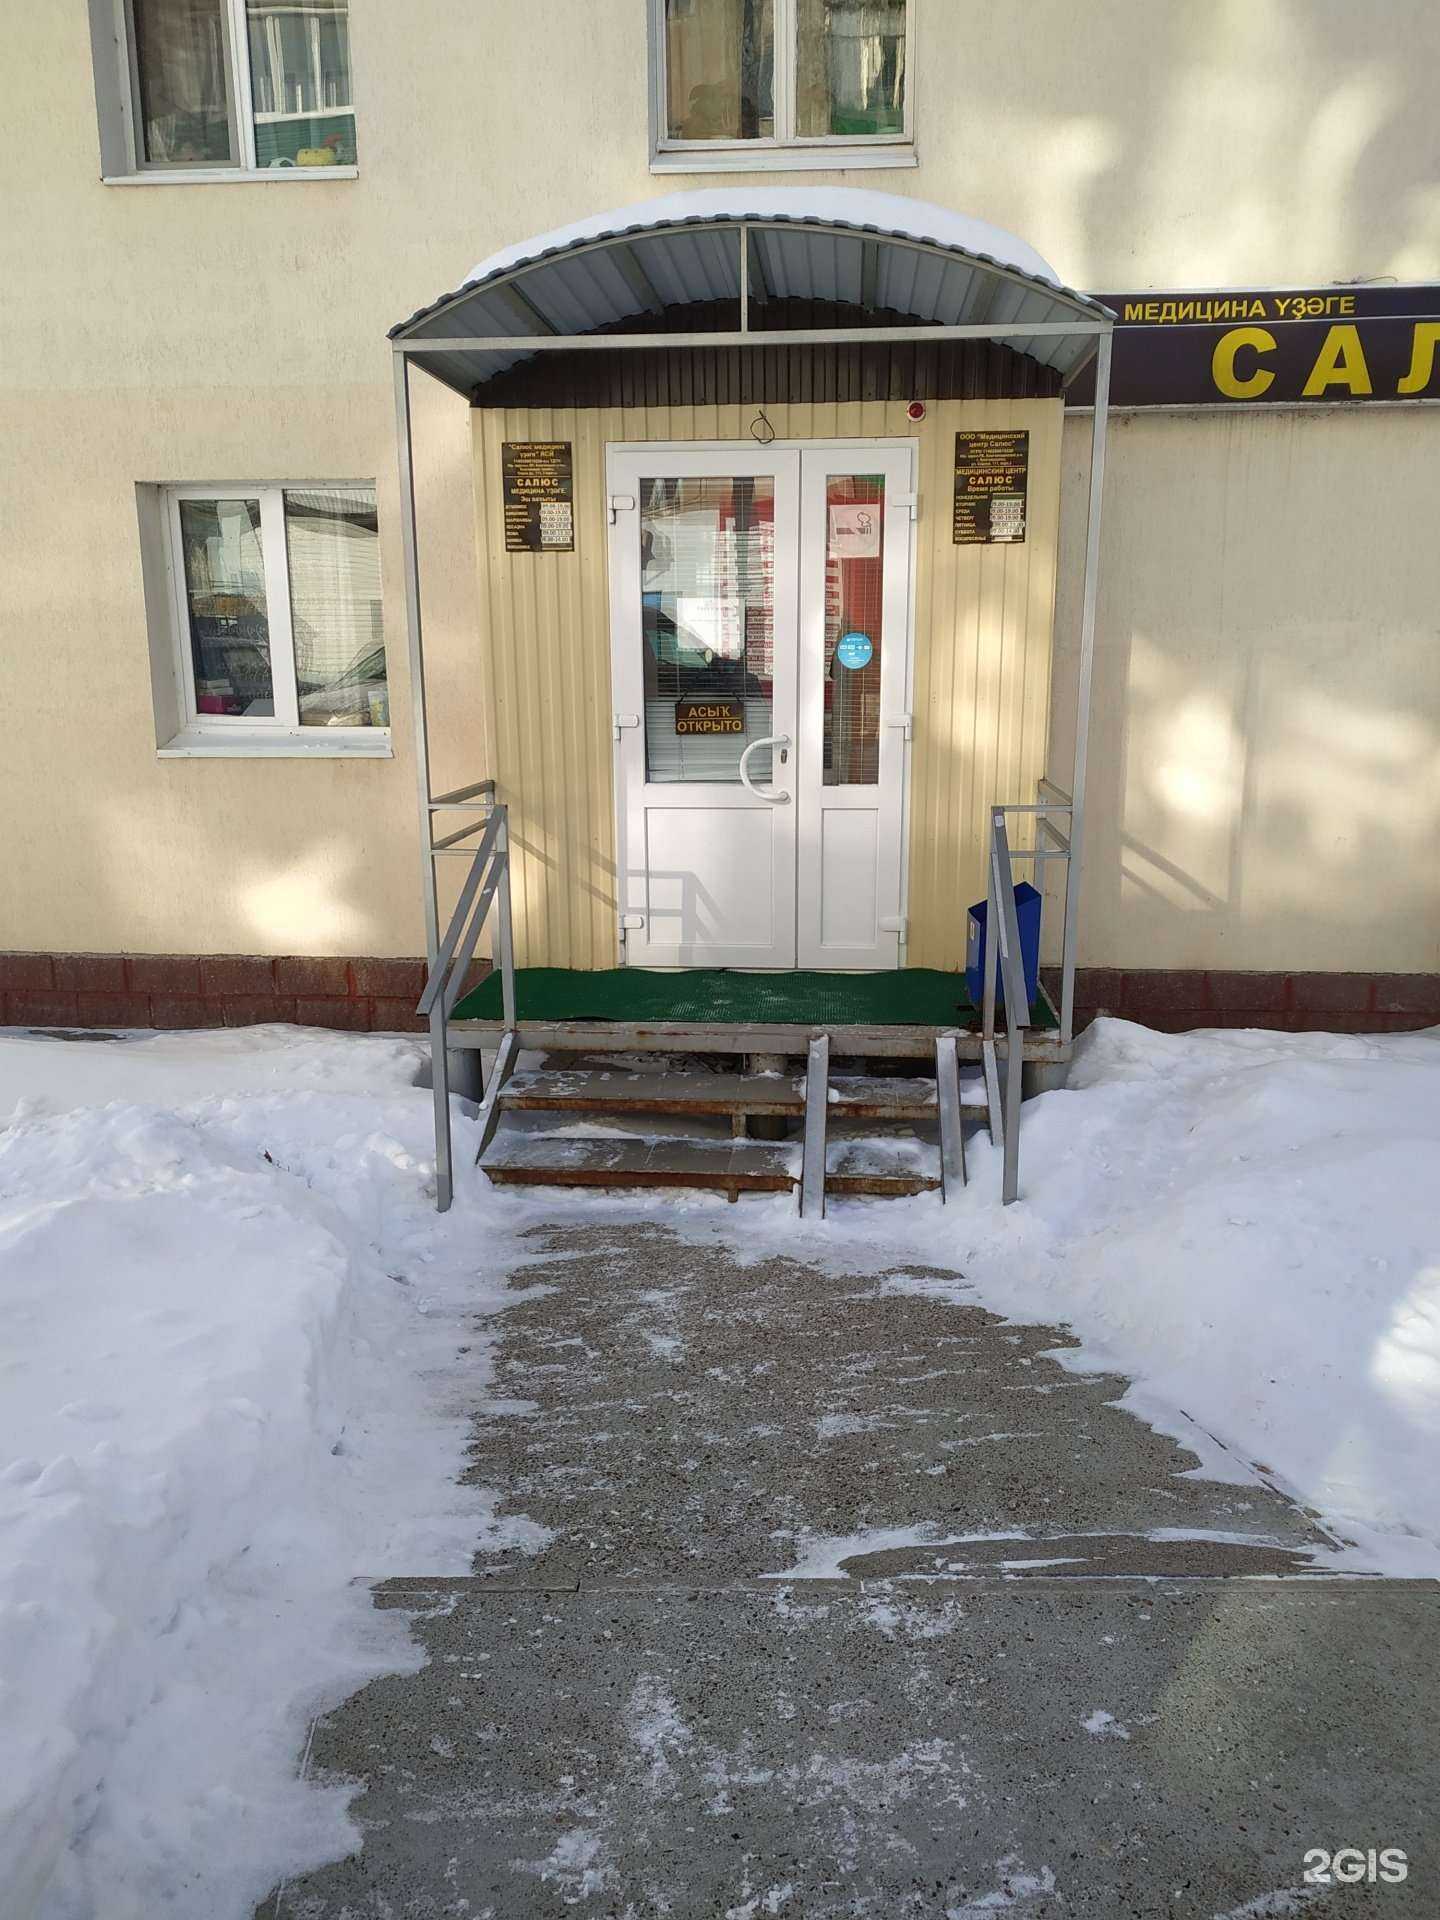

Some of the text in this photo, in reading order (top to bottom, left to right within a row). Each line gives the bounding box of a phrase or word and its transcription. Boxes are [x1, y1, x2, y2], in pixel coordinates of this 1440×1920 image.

[1124, 296, 1267, 324] МЕДИЦИНА
[517, 478, 559, 487] САЛЮС
[968, 475, 1013, 485] САЛЮС
[677, 720, 742, 732] ОТКРЫТО
